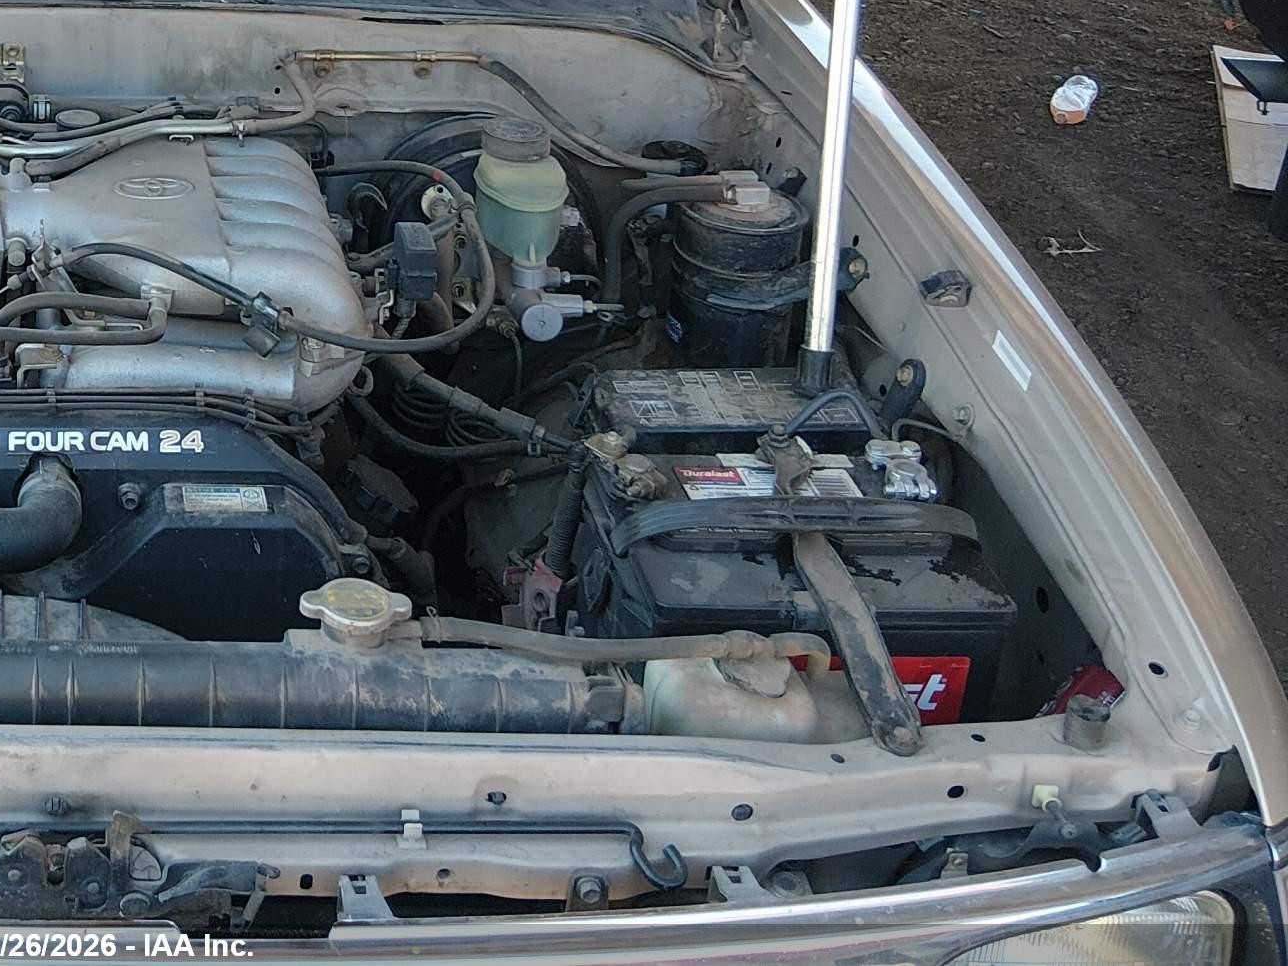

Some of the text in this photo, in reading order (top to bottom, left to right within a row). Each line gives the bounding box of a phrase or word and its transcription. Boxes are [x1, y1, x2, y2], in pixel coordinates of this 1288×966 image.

[7, 431, 84, 452] FOUR
[89, 431, 149, 452] CAM
[160, 430, 205, 453] 24
[679, 468, 736, 479] Duralast
